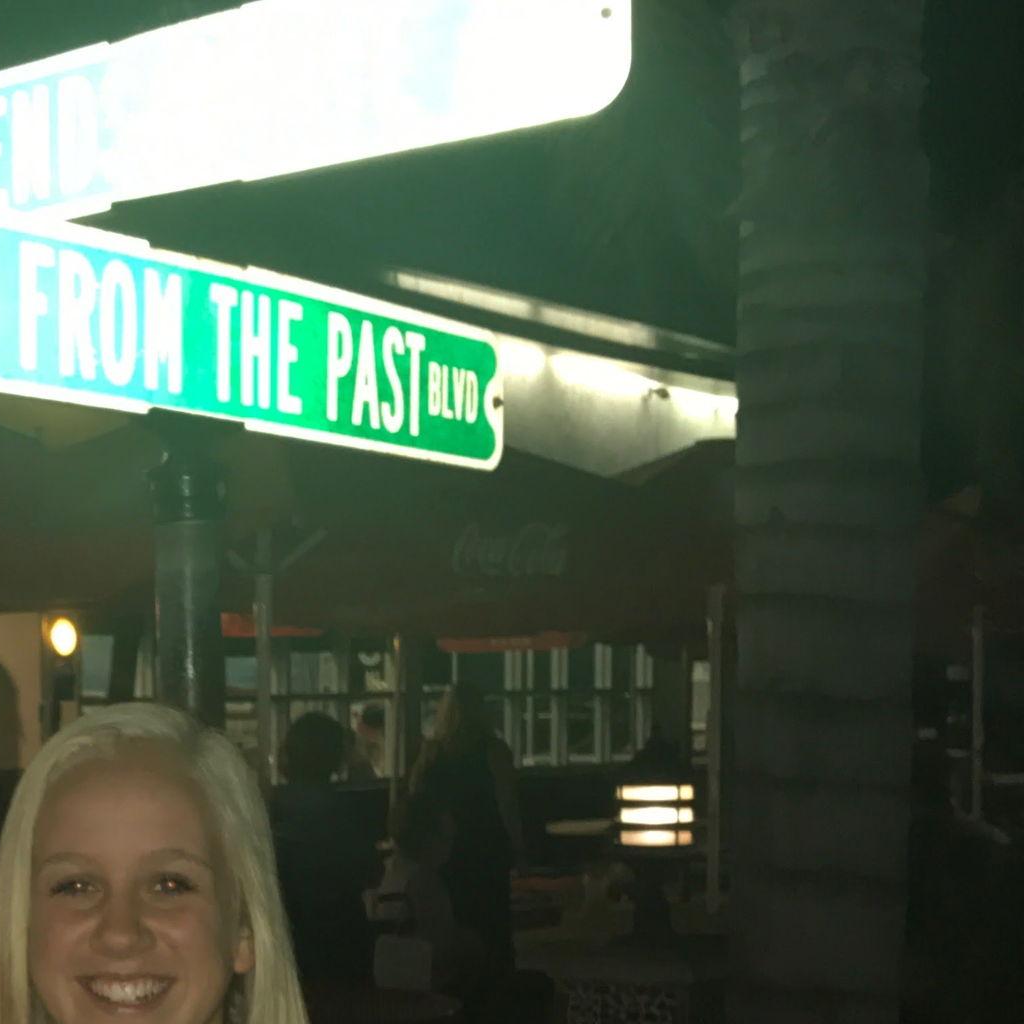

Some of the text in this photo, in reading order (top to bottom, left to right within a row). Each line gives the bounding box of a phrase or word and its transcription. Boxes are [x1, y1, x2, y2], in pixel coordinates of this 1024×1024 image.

[19, 240, 182, 395] FROM
[209, 282, 304, 415] THE
[327, 311, 425, 437] PAST
[428, 361, 479, 424] BLVD
